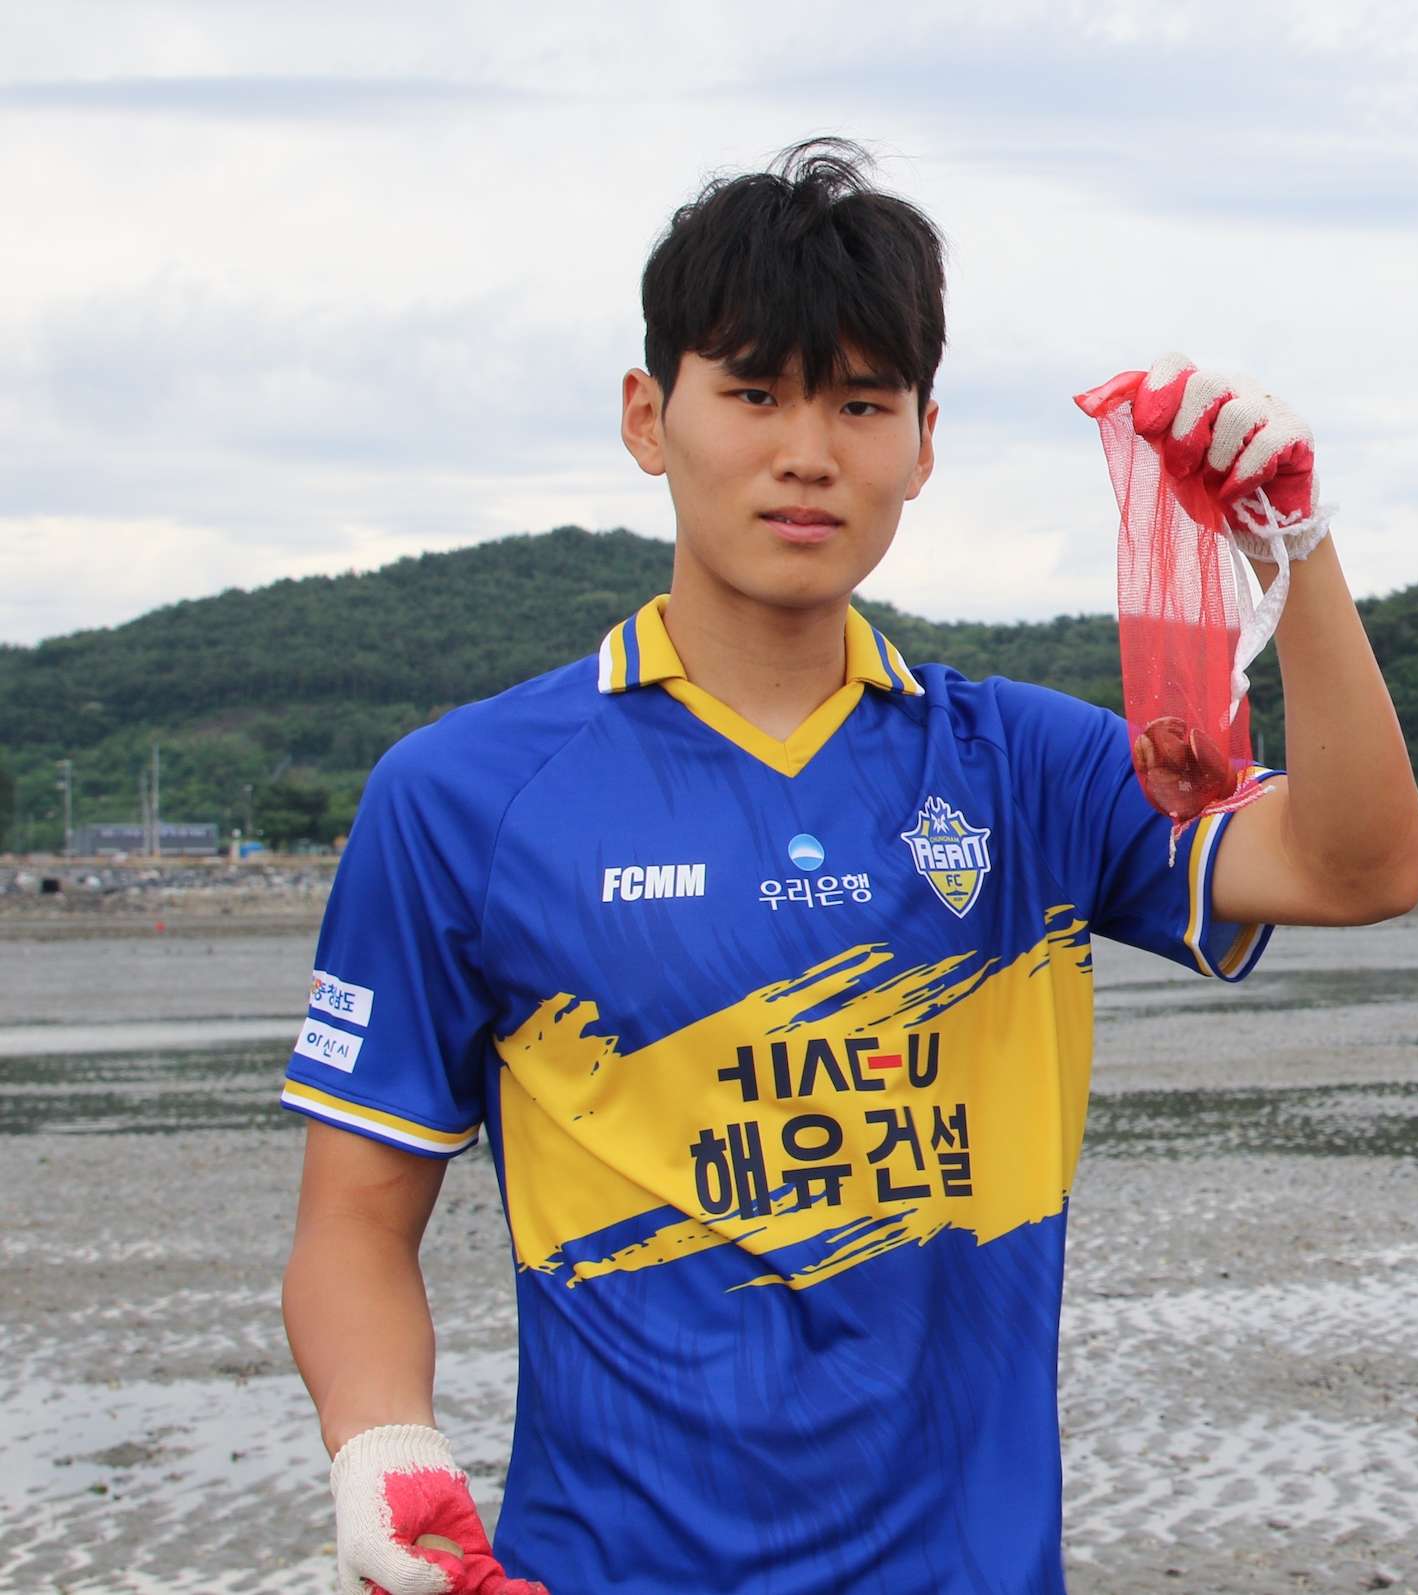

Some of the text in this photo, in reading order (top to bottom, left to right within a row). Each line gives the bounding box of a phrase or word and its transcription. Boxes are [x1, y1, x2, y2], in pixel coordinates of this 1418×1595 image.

[911, 835, 984, 869] ASAN
[602, 863, 706, 903] FCMM
[759, 873, 873, 911] 우리은행
[945, 874, 963, 887] FC
[690, 1104, 973, 1220] 해유건설
